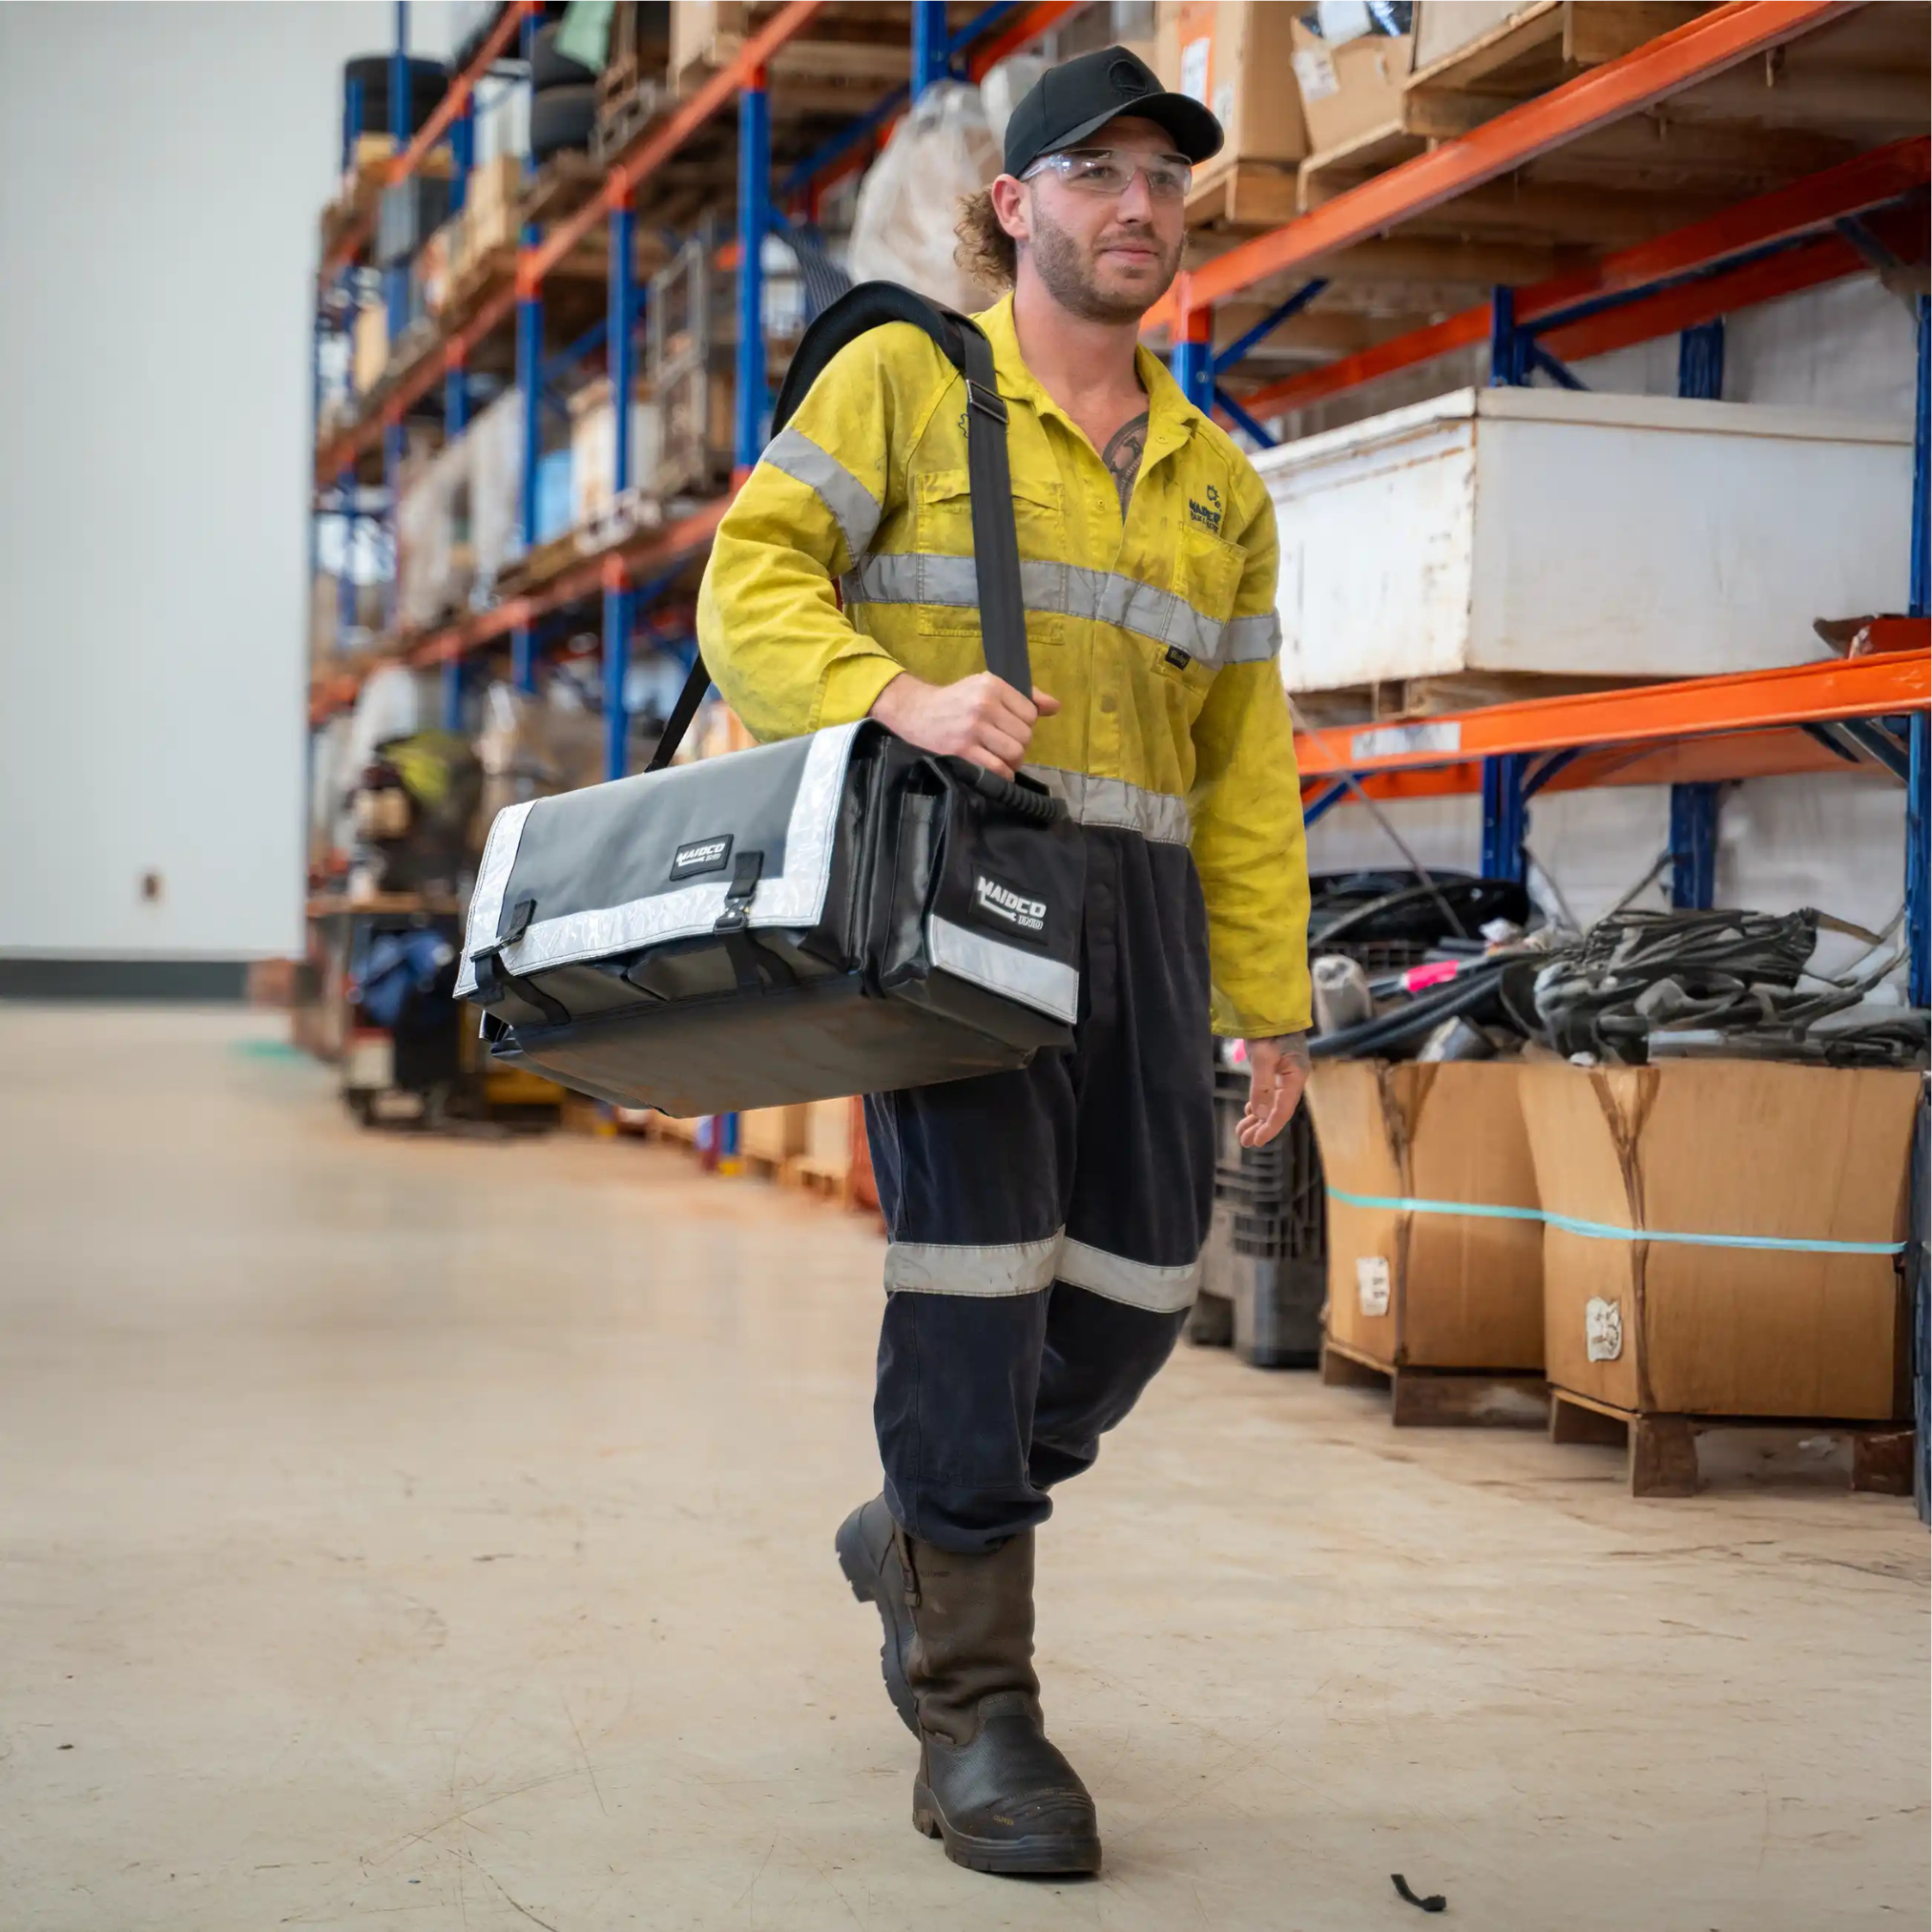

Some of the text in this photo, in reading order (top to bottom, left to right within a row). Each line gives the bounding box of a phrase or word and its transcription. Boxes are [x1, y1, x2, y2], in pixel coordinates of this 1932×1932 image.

[675, 842, 726, 864] MAIDCO
[977, 876, 1047, 918] MAIDCO
[1018, 915, 1044, 930] IND
